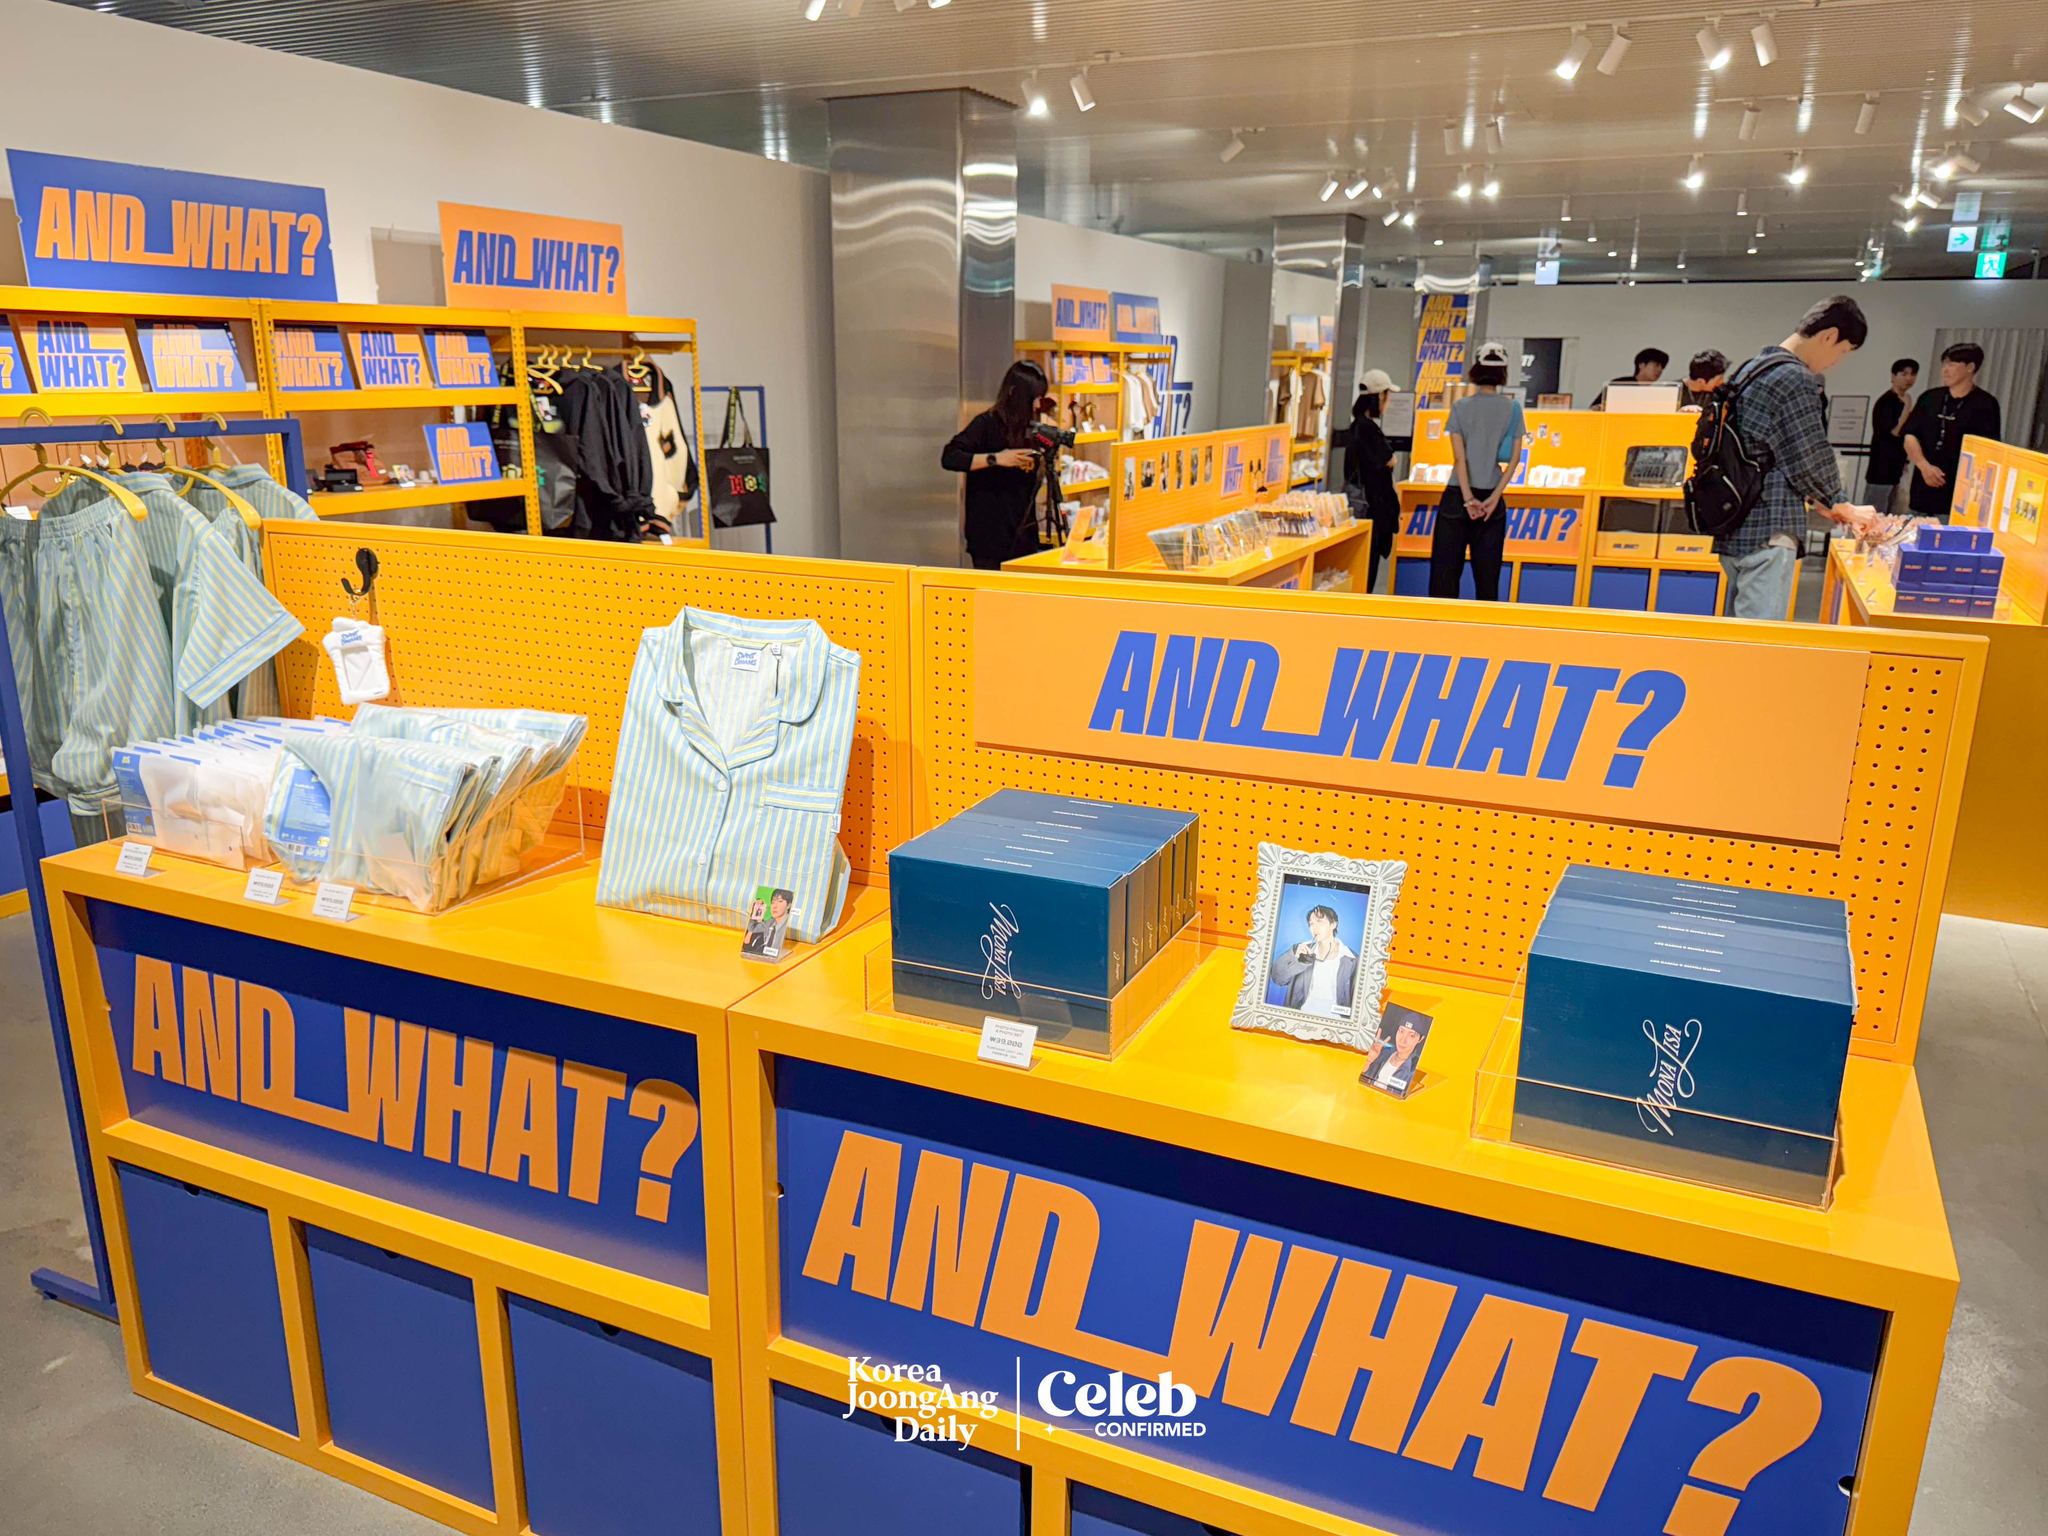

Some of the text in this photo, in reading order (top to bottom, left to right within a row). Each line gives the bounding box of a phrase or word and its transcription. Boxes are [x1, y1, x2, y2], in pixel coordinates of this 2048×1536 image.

[38, 355, 127, 388] WHAT?
[153, 356, 234, 388] WHAT?
[276, 357, 343, 387] WHAT?
[362, 358, 421, 386] WHAT?
[436, 358, 491, 385] WHAT?
[437, 453, 492, 481] WHAT?
